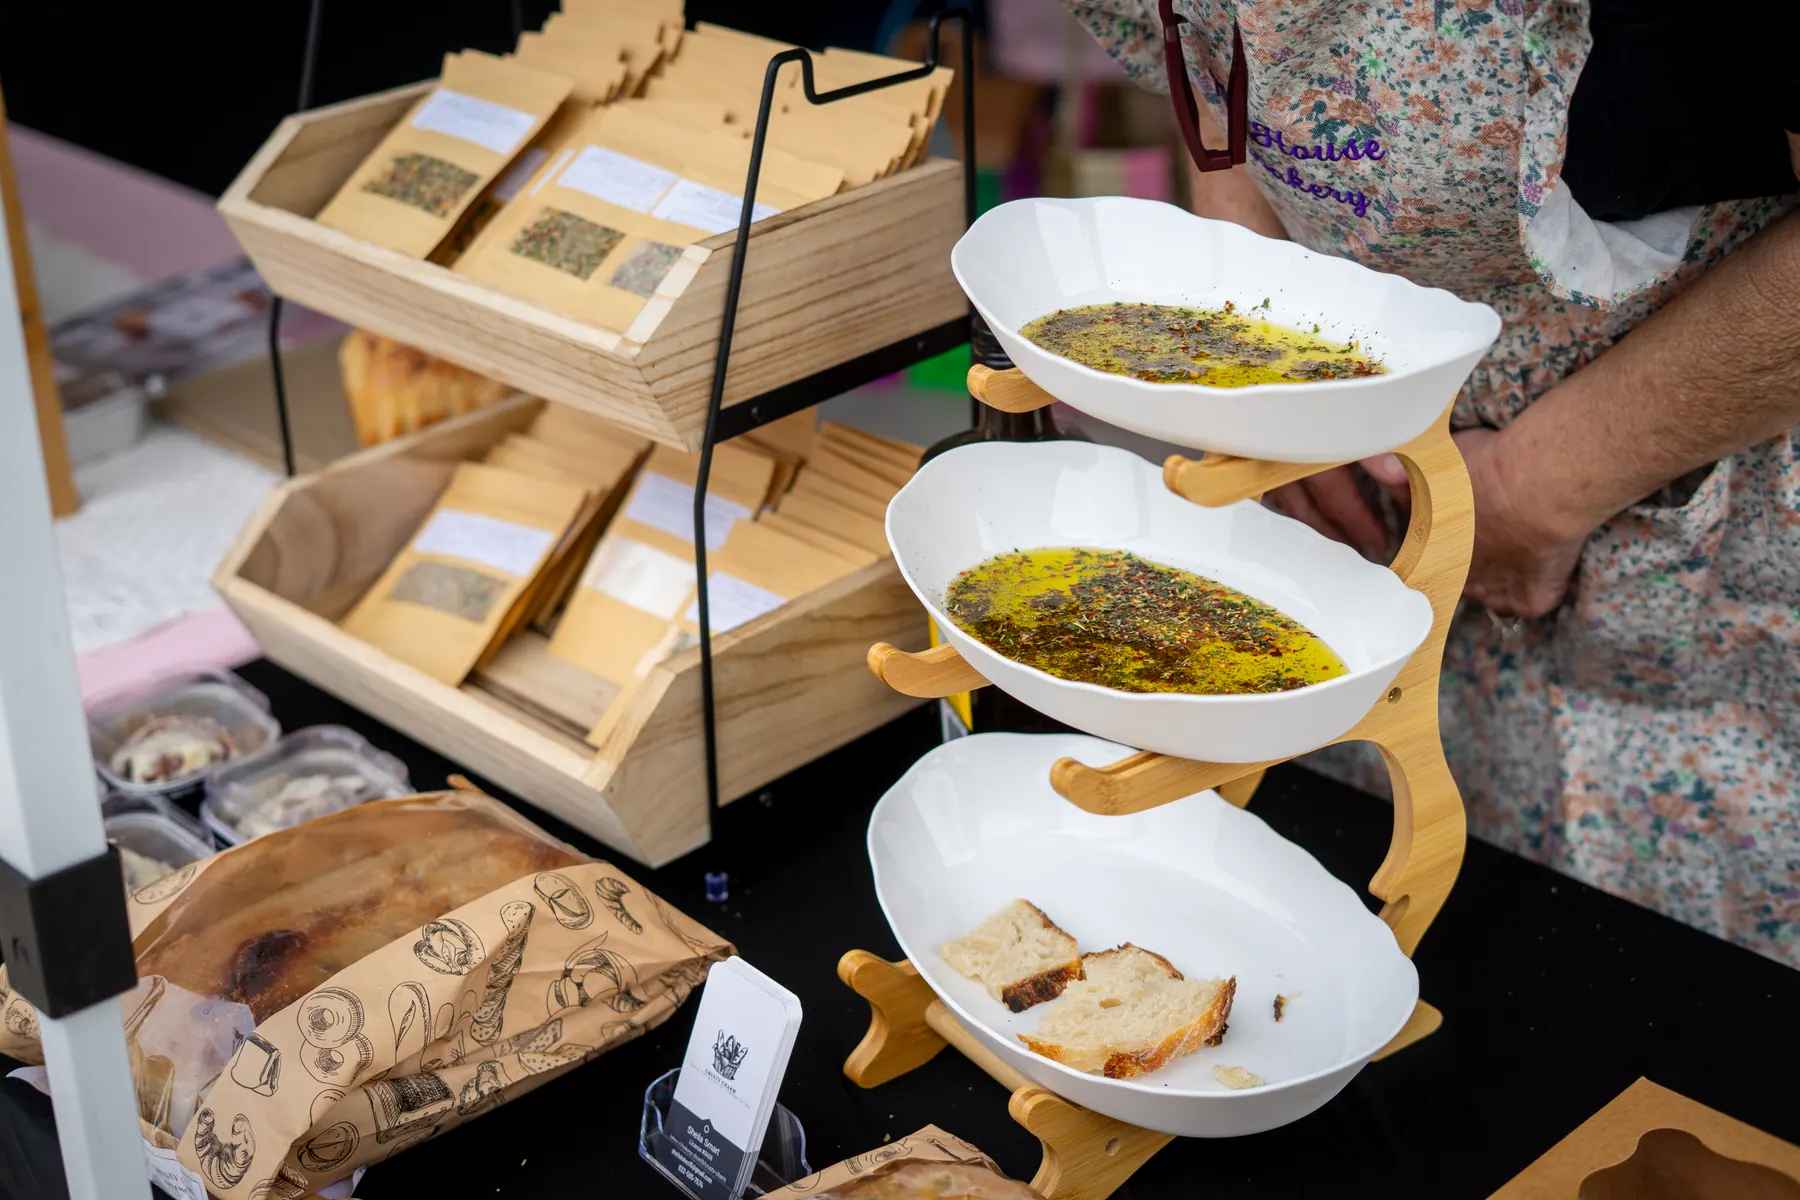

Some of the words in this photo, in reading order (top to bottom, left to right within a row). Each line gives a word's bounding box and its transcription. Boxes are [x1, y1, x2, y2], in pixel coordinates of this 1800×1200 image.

[1250, 120, 1386, 162] House
[1249, 150, 1372, 218] akery
[704, 1068, 721, 1083] CRUSTY
[721, 1080, 737, 1095] CHARM
[687, 1125, 704, 1144] Sheila
[703, 1138, 720, 1156] Smart
